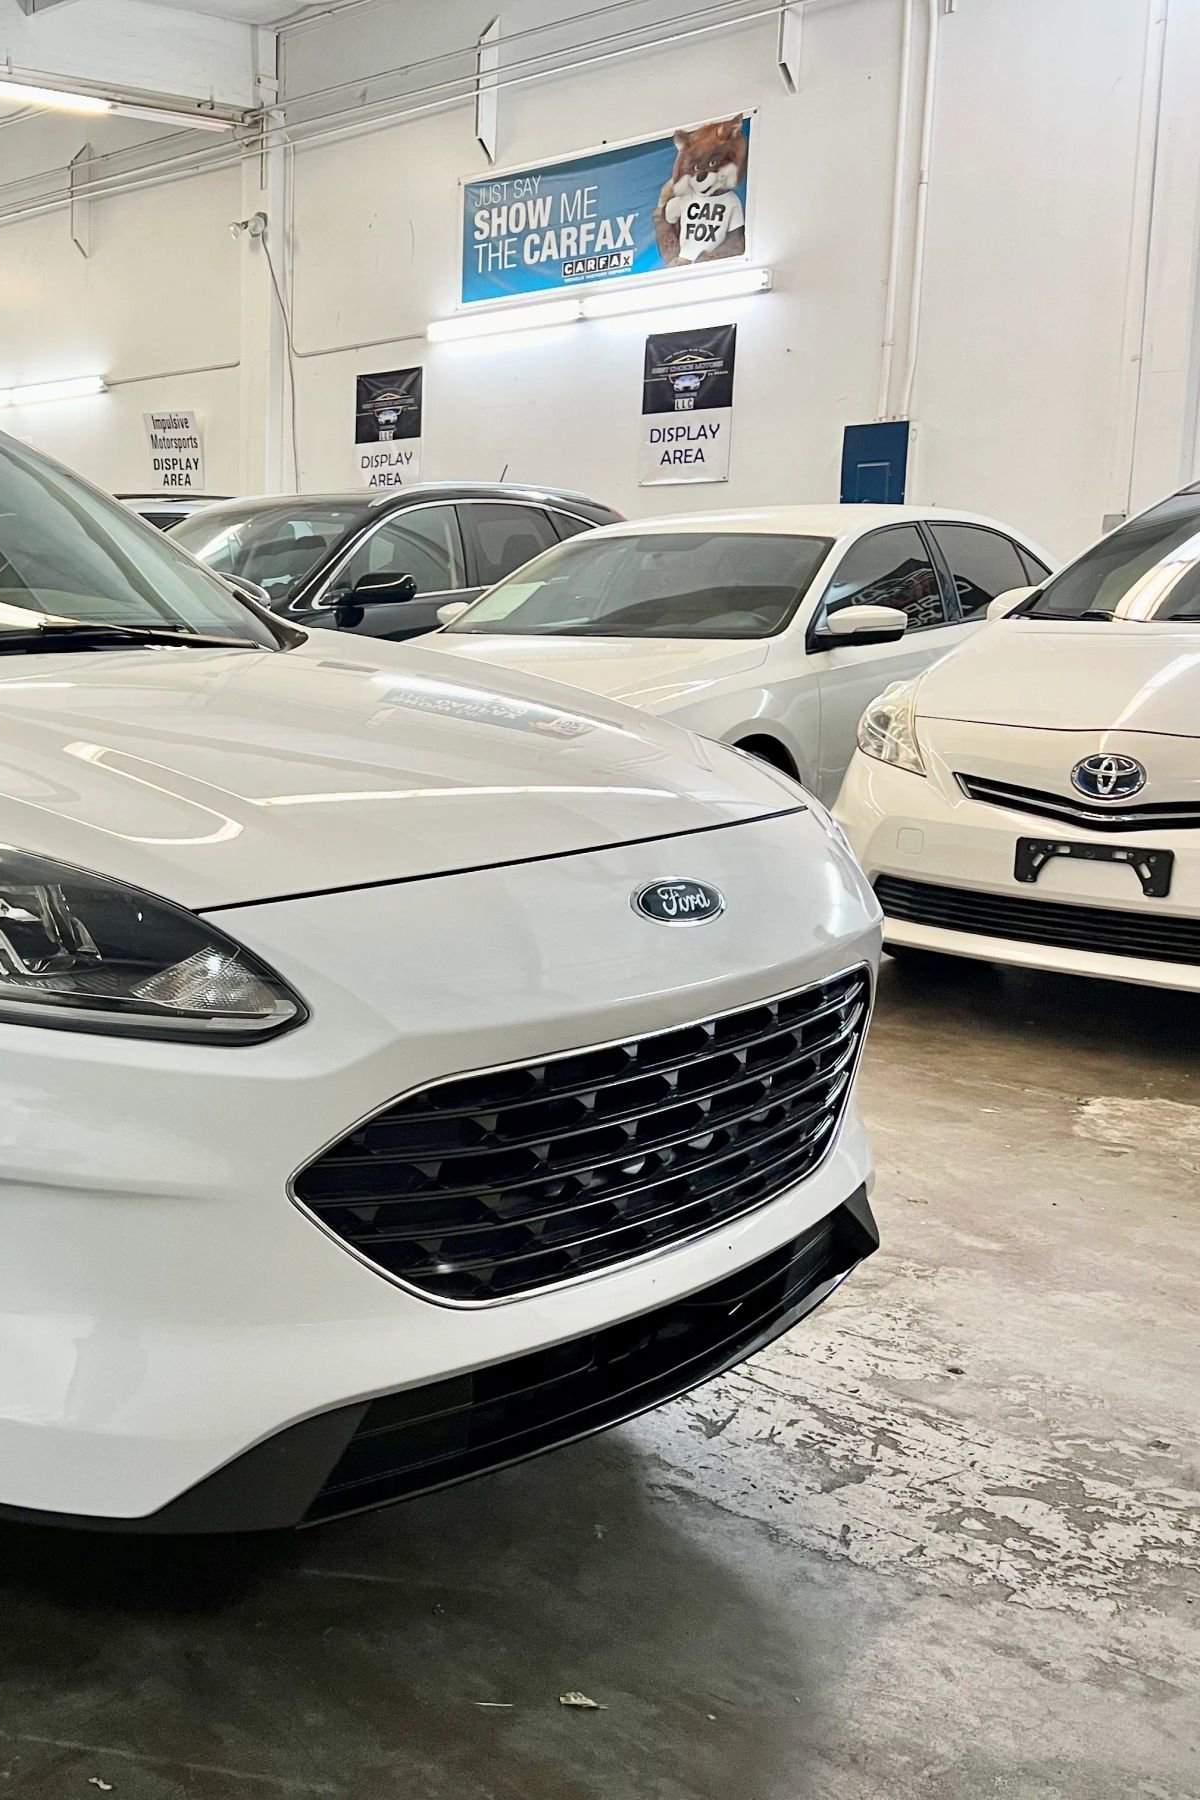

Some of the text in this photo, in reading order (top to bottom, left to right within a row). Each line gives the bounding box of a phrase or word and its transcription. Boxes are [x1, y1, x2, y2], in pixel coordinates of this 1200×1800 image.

[475, 175, 542, 208] JUST SAY
[474, 186, 598, 240] SHOW ME
[687, 202, 726, 222] CAR
[685, 223, 720, 243] FOX
[474, 213, 635, 274] THE CARFAX
[563, 251, 633, 277] CARFAX
[676, 398, 694, 410] LLC
[151, 414, 189, 433] Impulsive
[151, 434, 198, 452] Motorsports
[650, 423, 720, 444] DISPLAY
[153, 458, 199, 471] DISPLAY
[361, 452, 413, 469] DISPLAY
[660, 448, 705, 465] AREA
[163, 473, 191, 486] AREA
[369, 472, 402, 487] AREA
[657, 885, 711, 916] Ford
